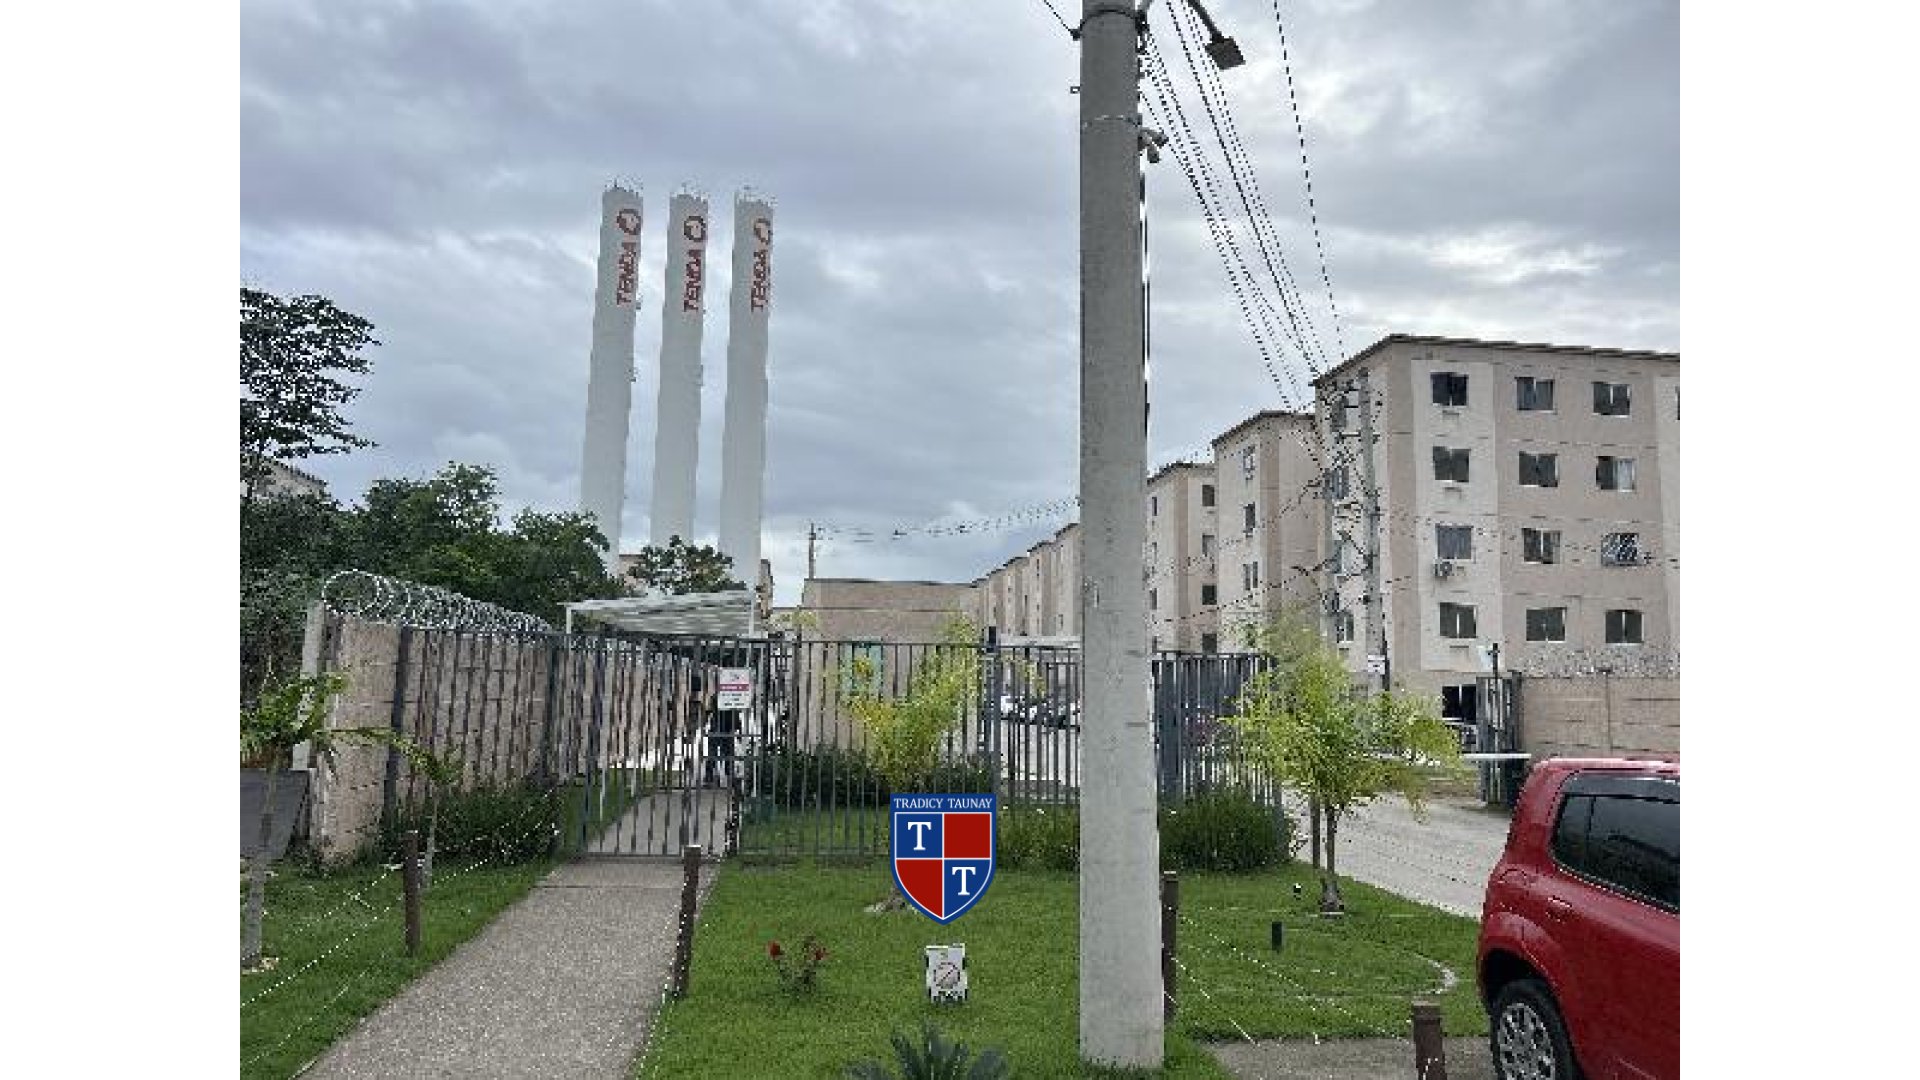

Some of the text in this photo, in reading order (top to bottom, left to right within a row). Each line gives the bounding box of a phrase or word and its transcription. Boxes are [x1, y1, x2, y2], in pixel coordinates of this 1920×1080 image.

[616, 241, 637, 306] TENDA
[683, 249, 701, 312] TENDA
[751, 249, 769, 312] TENDA
